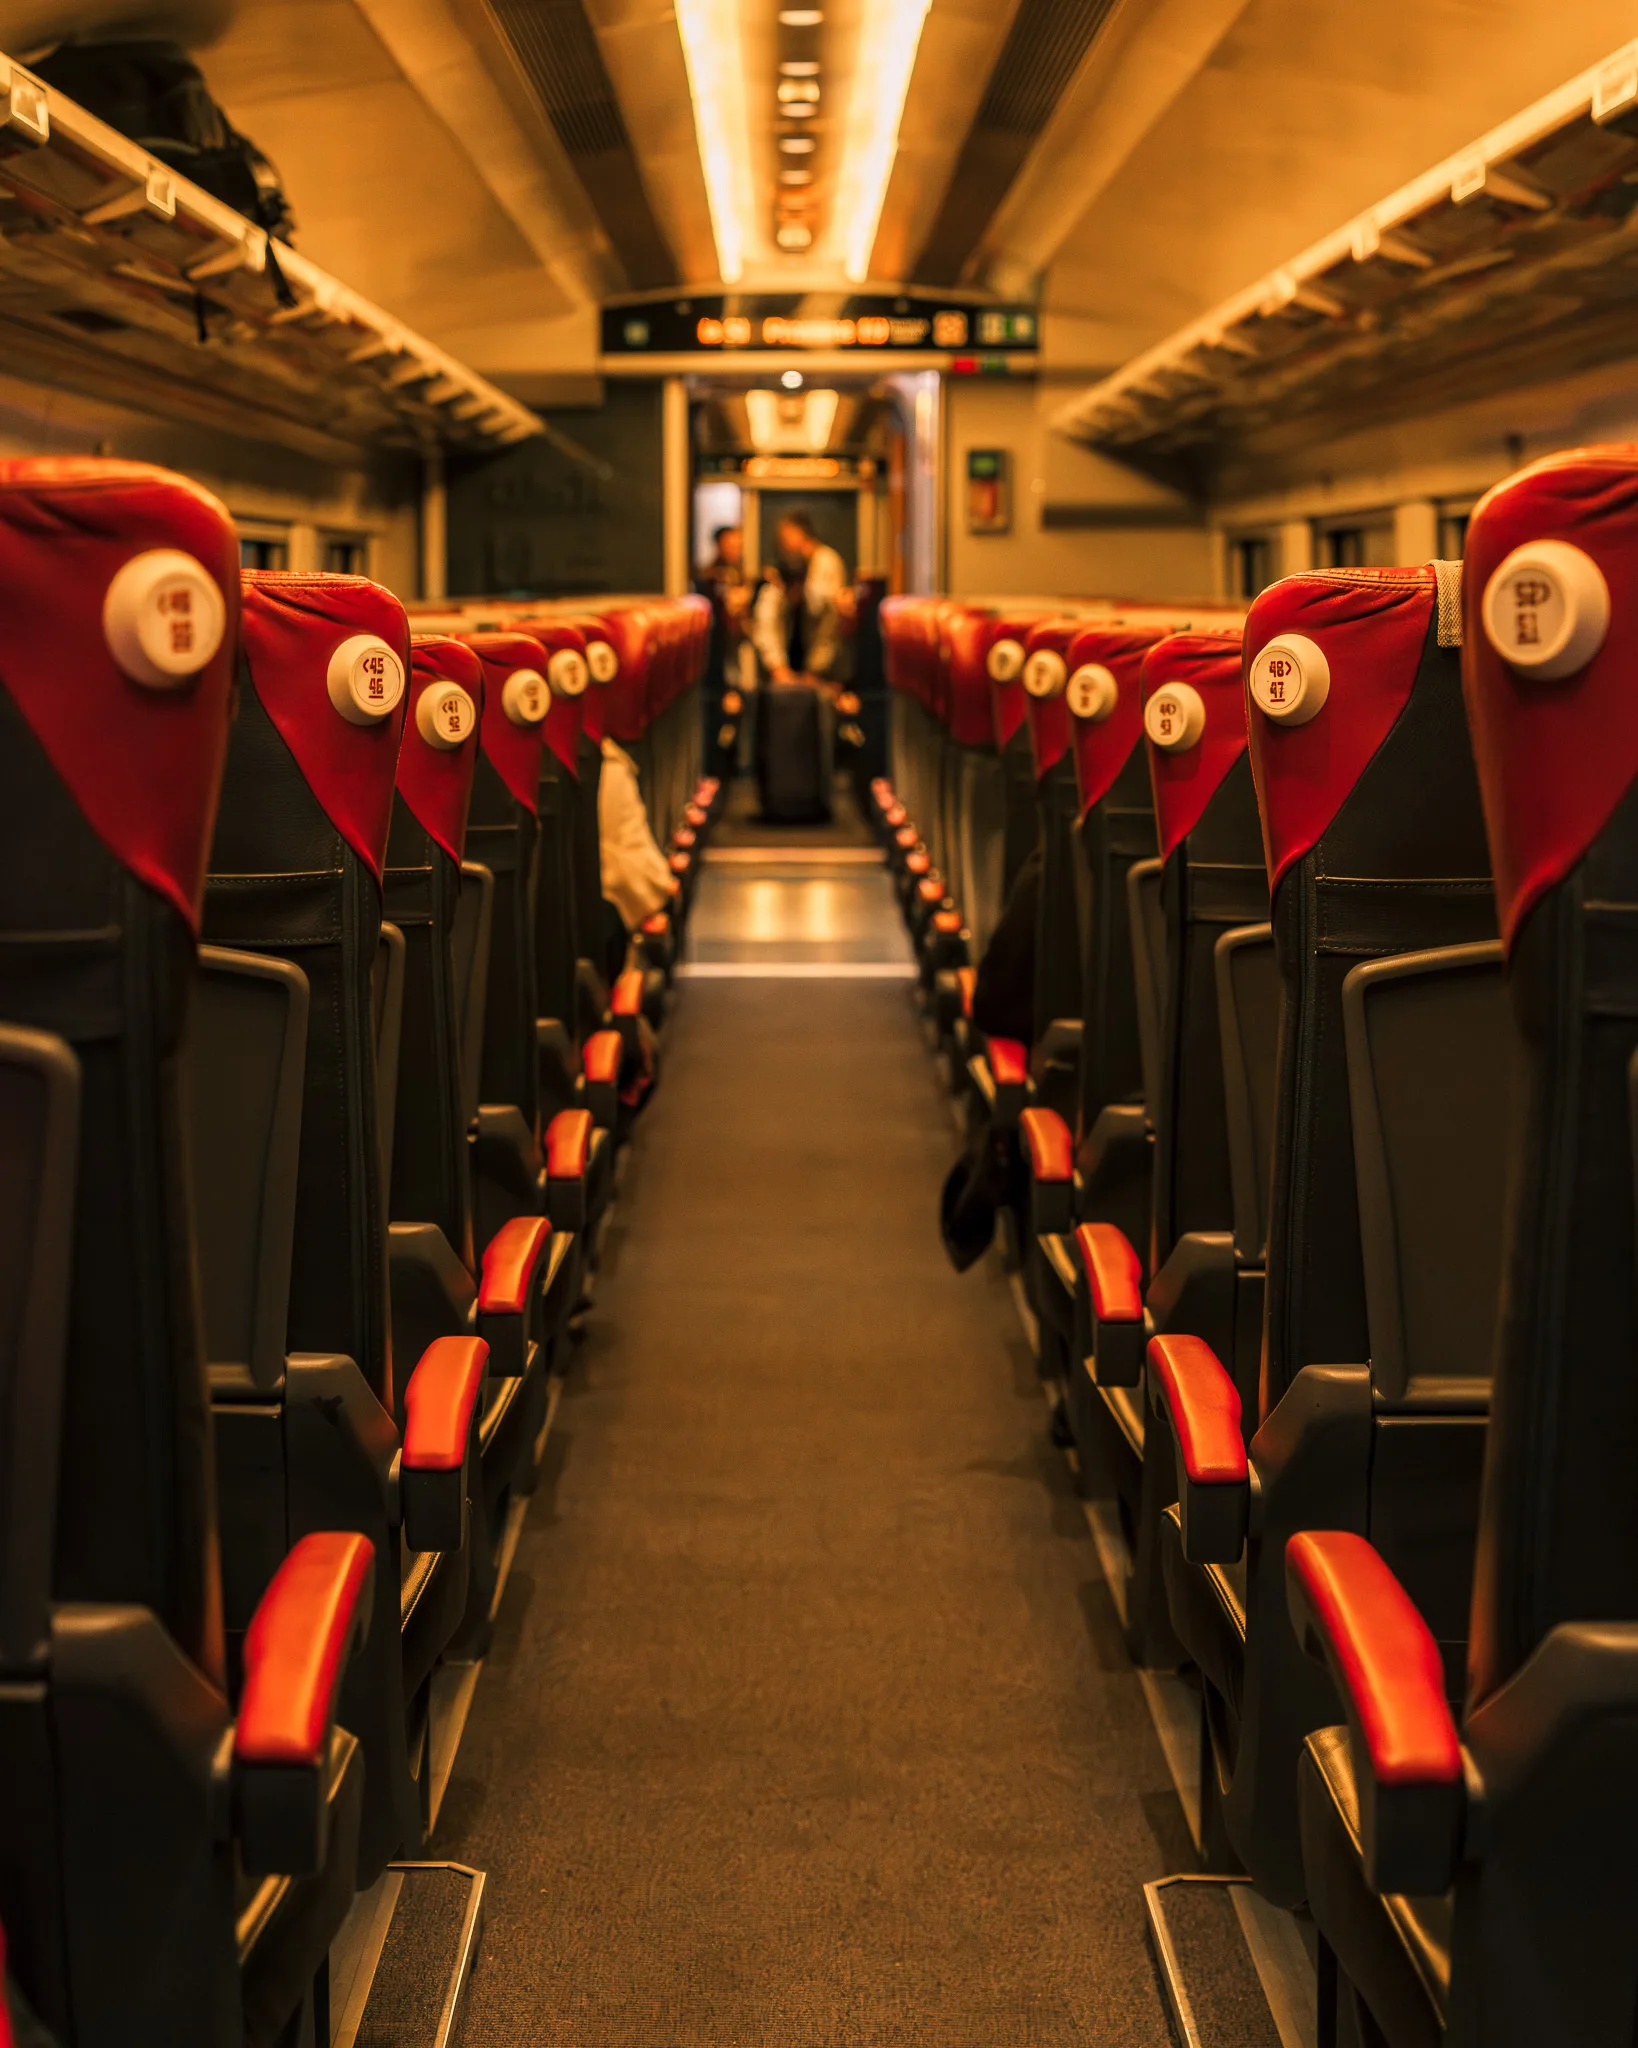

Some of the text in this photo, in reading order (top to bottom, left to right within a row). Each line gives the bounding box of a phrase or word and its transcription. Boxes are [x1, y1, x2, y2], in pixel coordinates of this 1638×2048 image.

[370, 658, 384, 674] 45
[1269, 661, 1284, 677] 48
[369, 678, 383, 694] 46
[1270, 682, 1284, 698] 47
